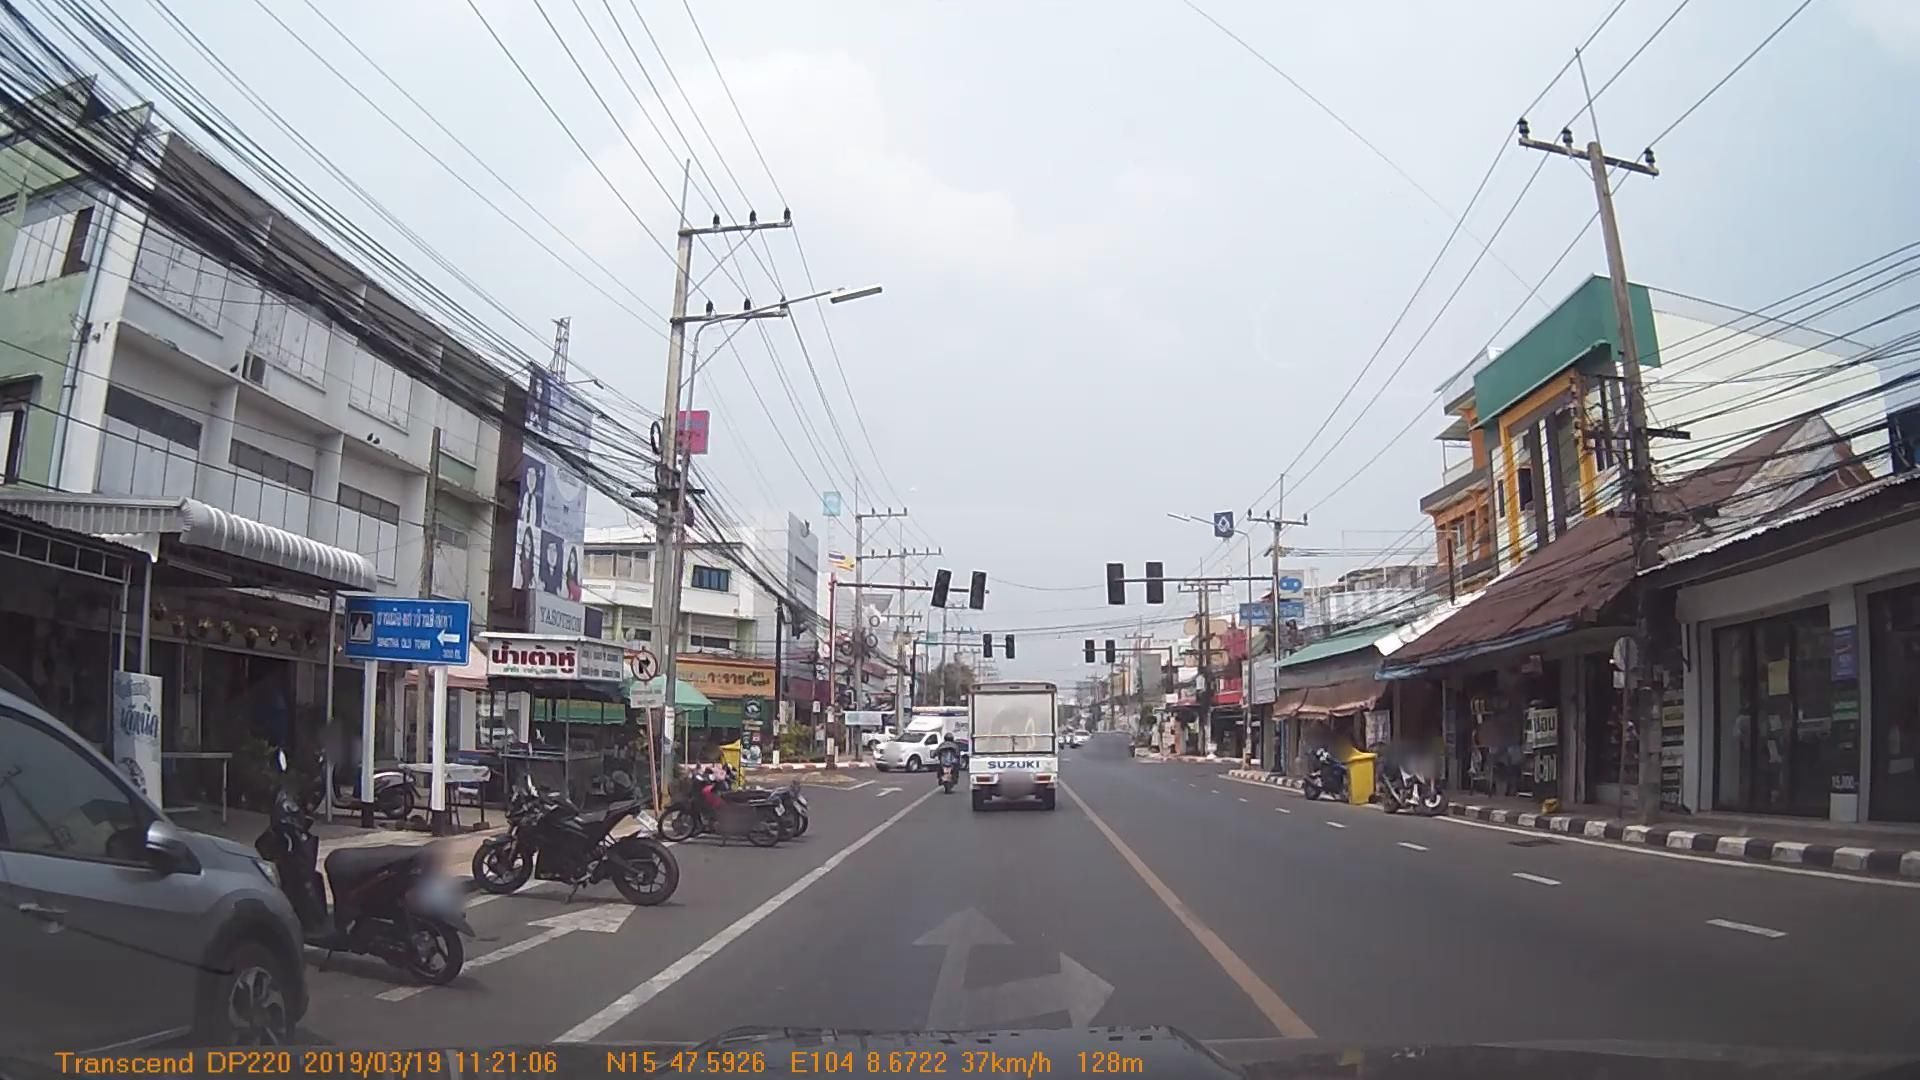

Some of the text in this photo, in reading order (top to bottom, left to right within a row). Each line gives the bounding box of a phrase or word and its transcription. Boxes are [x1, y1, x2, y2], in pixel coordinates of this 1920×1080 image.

[491, 640, 576, 674] น้ำเต้าหู้
[987, 760, 1040, 769] SUZUKI
